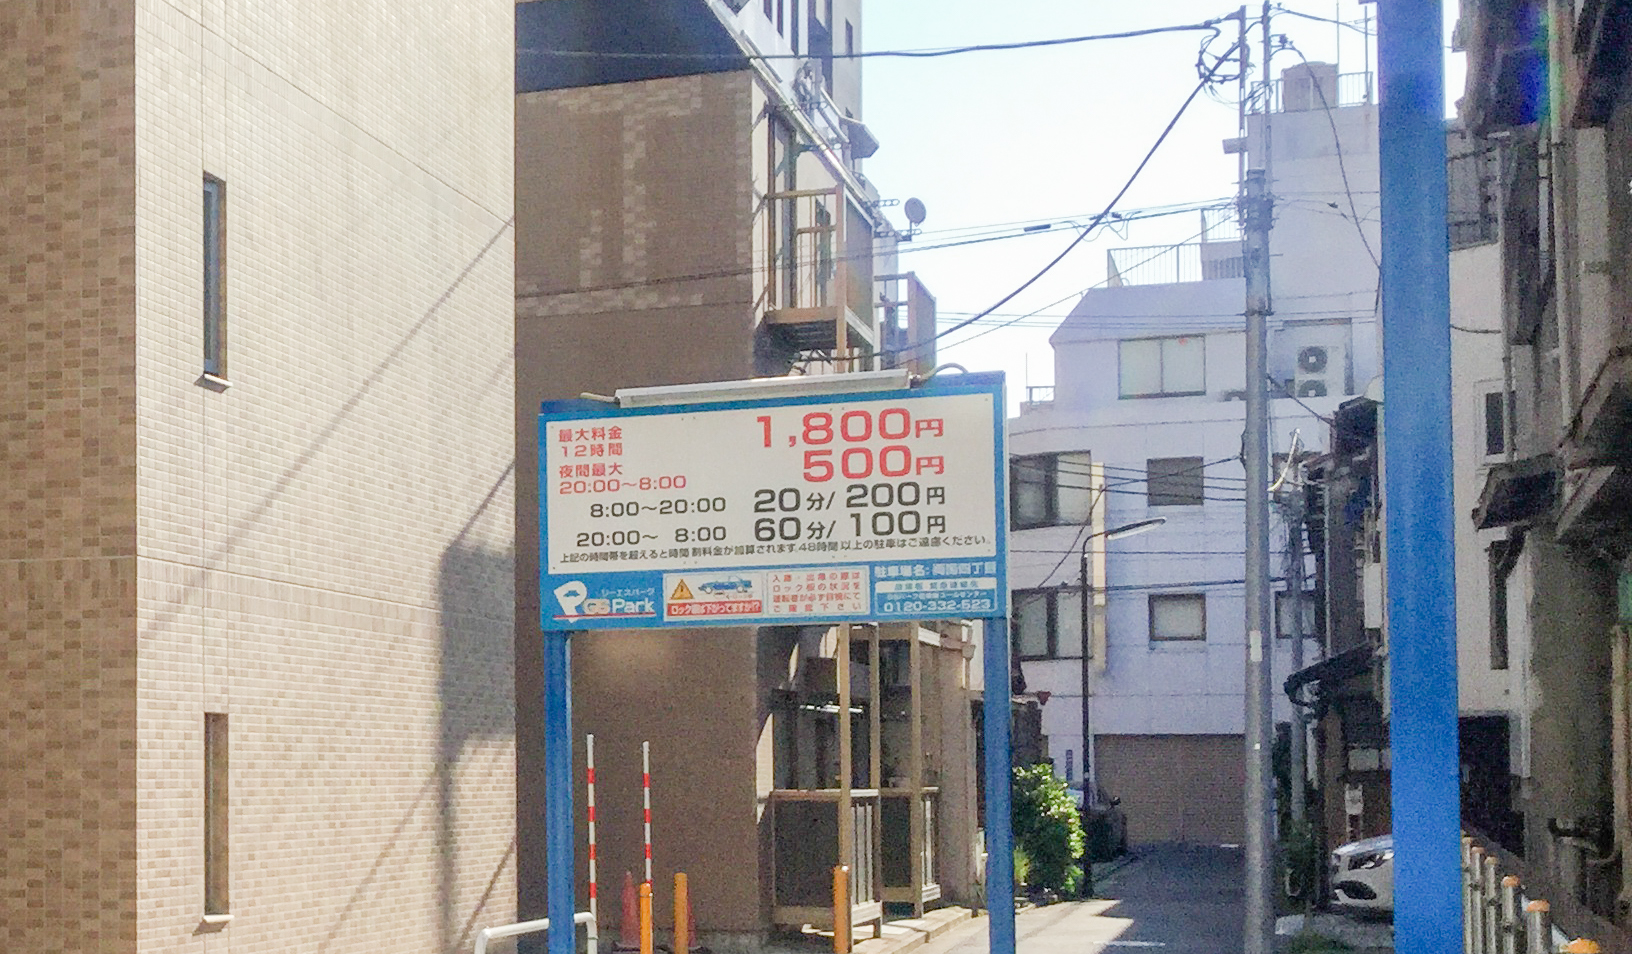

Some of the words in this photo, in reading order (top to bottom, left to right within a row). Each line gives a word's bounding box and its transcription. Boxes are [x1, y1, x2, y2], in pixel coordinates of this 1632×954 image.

[558, 425, 623, 442] 最大料金
[756, 407, 945, 448] 1,800円
[561, 442, 623, 457] 12時間
[559, 462, 623, 478] 夜間最大
[802, 444, 945, 483] 500円
